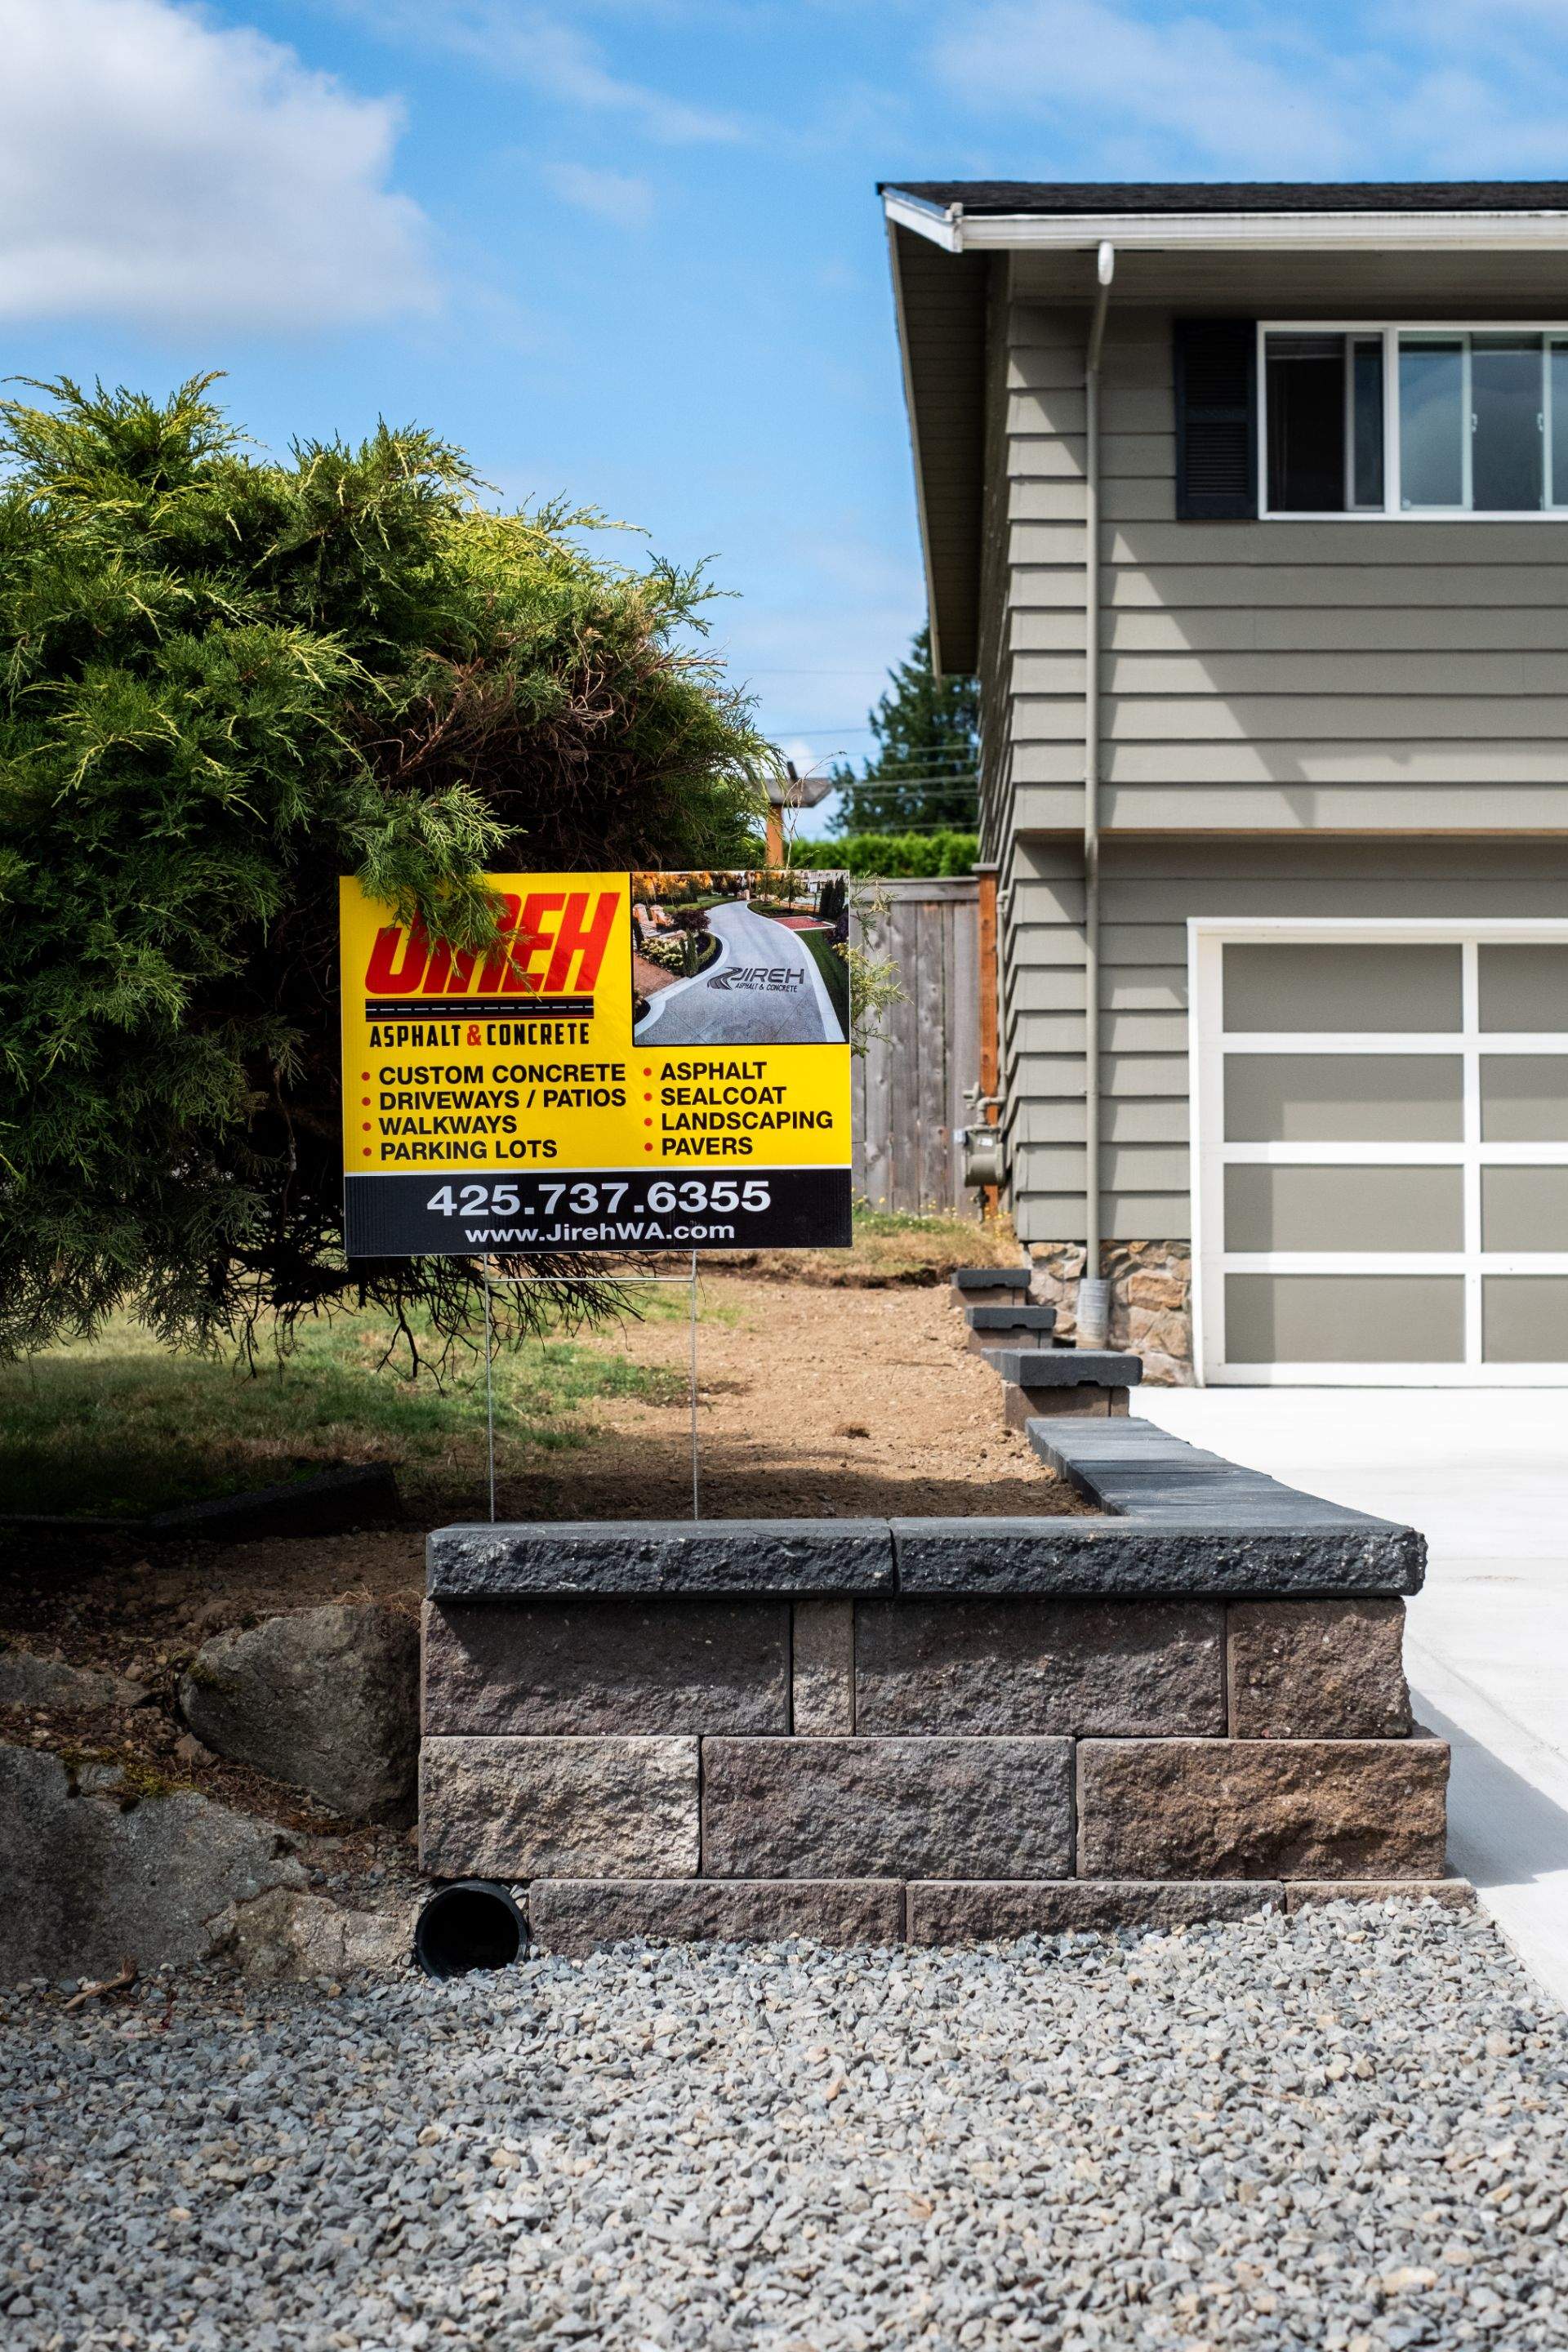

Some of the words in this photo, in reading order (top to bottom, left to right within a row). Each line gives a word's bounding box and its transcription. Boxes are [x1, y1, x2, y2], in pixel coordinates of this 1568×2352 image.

[731, 969, 804, 984] JIREH
[766, 984, 798, 993] CONCRETE
[369, 1024, 461, 1048] ASPHALT
[466, 1023, 482, 1046] &
[487, 1023, 590, 1045] CONCRETE
[379, 1065, 483, 1085] CUSTOM
[492, 1063, 626, 1084] CONCRETE
[660, 1062, 767, 1080] ASPHALT
[380, 1089, 519, 1111] DRIVEWAYS
[526, 1089, 536, 1108] /
[543, 1088, 626, 1108] PATIOS
[661, 1086, 786, 1107] SEALCOAT
[378, 1115, 518, 1136] WALKWAYS
[662, 1111, 833, 1131] LANDSCAPING
[381, 1140, 488, 1161] PARKING
[495, 1139, 558, 1159] LOTS
[662, 1136, 753, 1156] PAVERS
[427, 1181, 771, 1216] 425.737.6355
[465, 1222, 735, 1243] www.JirehWA.com
